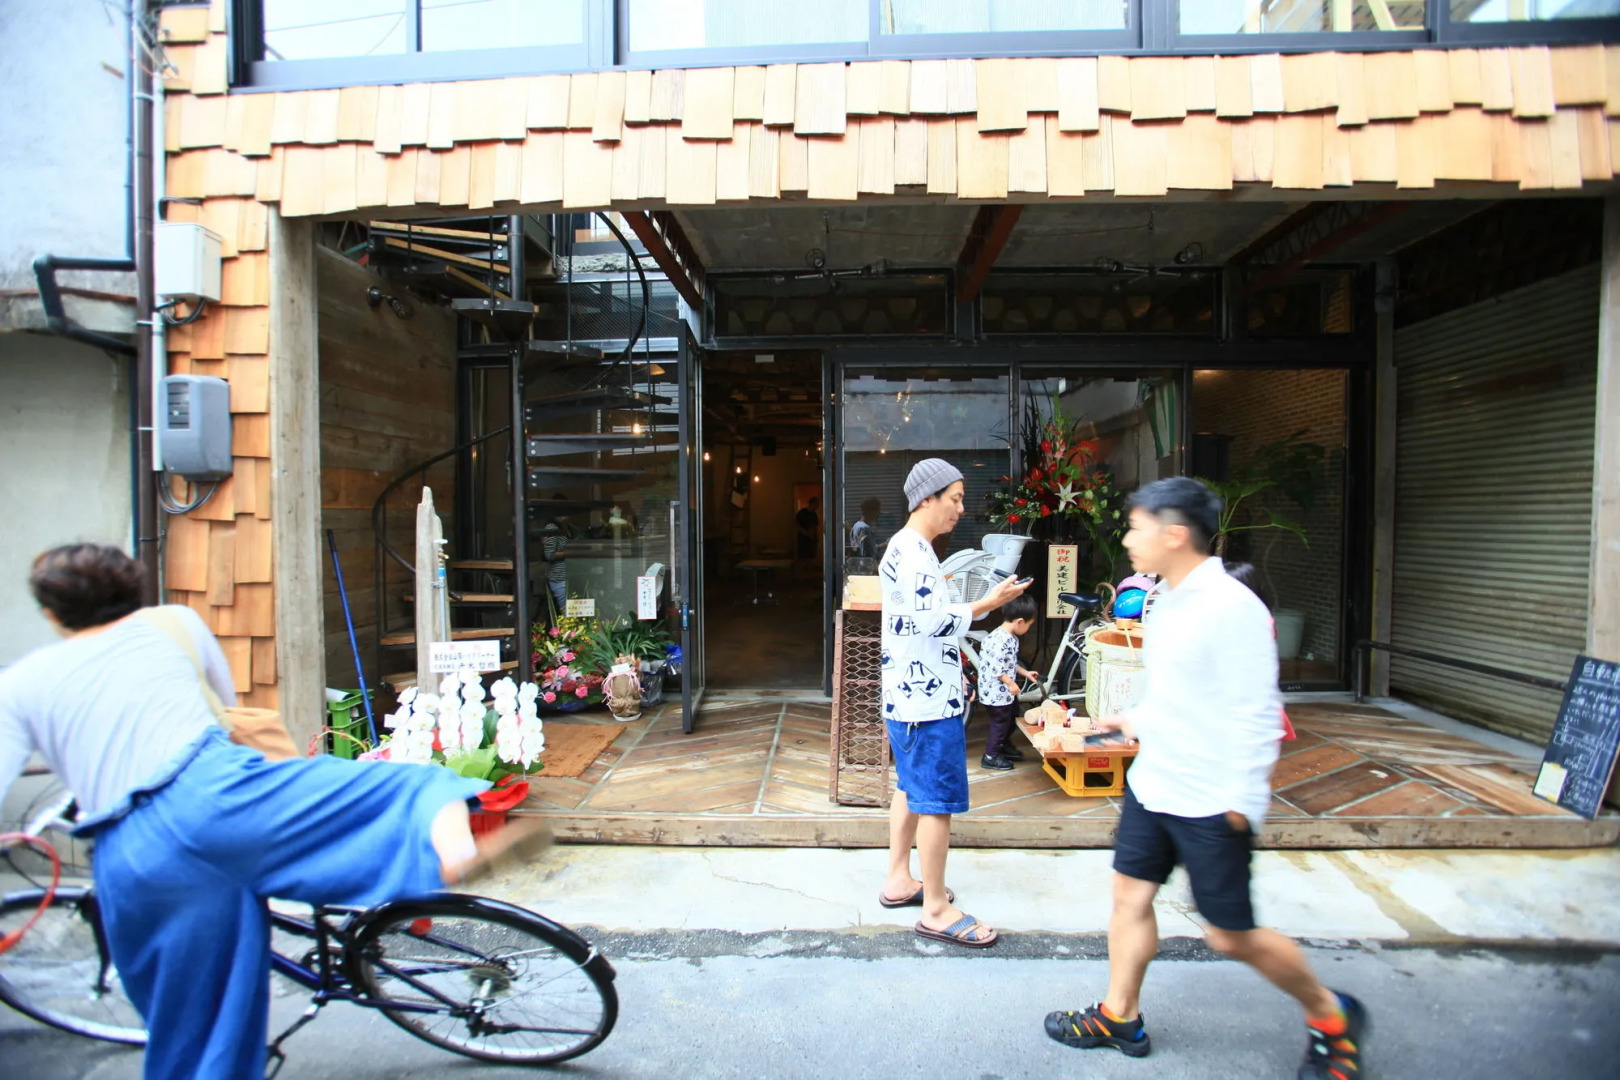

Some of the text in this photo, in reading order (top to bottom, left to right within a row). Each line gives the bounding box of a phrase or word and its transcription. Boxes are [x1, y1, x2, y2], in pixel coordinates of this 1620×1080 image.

[1057, 548, 1070, 563] 御祝
[1056, 565, 1070, 615] 美建ビル会社
